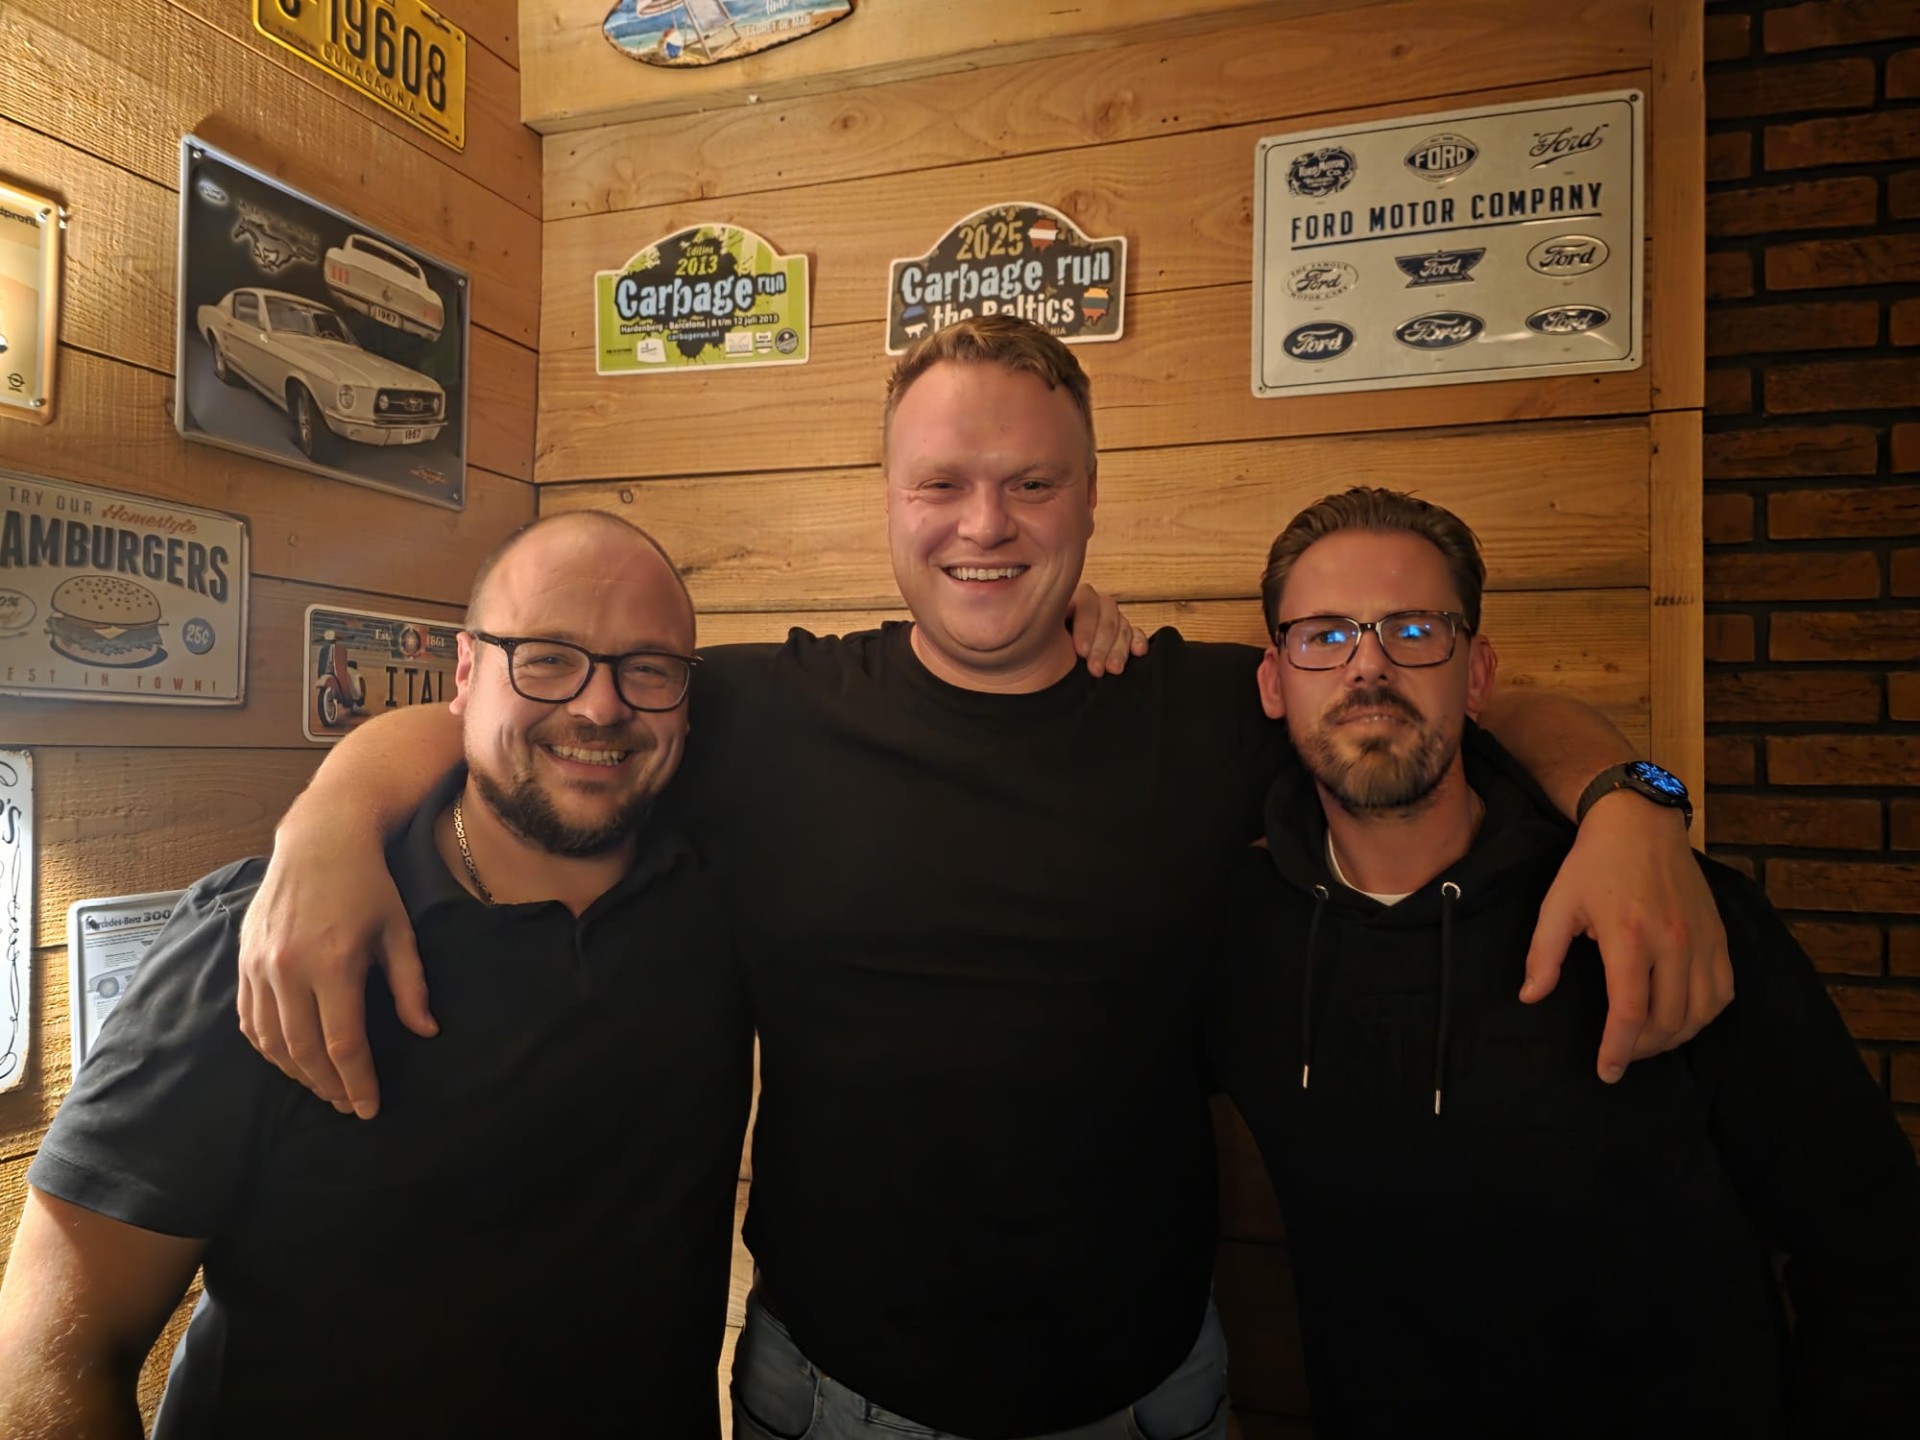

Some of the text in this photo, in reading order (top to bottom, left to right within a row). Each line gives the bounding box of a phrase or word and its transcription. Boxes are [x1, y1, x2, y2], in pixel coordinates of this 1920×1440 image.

[1415, 145, 1468, 170] FORD
[1292, 182, 1603, 243] FORD MOTOR COMPANY
[956, 221, 1024, 261] 2025
[675, 255, 719, 276] 2013
[1420, 256, 1462, 277] Ford
[1539, 243, 1596, 268] Ford
[902, 252, 1111, 305] Carbage run
[1295, 268, 1343, 293] Ford
[617, 274, 786, 318] Carbage run
[378, 309, 397, 324] 1967
[621, 324, 664, 334] Hardenberg
[669, 321, 706, 330] Barcelona
[759, 314, 779, 323] 2013
[1542, 310, 1593, 332] Ford
[1292, 328, 1345, 355] Ford
[1403, 318, 1472, 342] Ford
[9, 486, 199, 535] TRY OUR Homestyle
[0, 509, 230, 602] AMBURGERS
[426, 635, 446, 648] 1861
[7, 666, 217, 693] EST IN TOWN!
